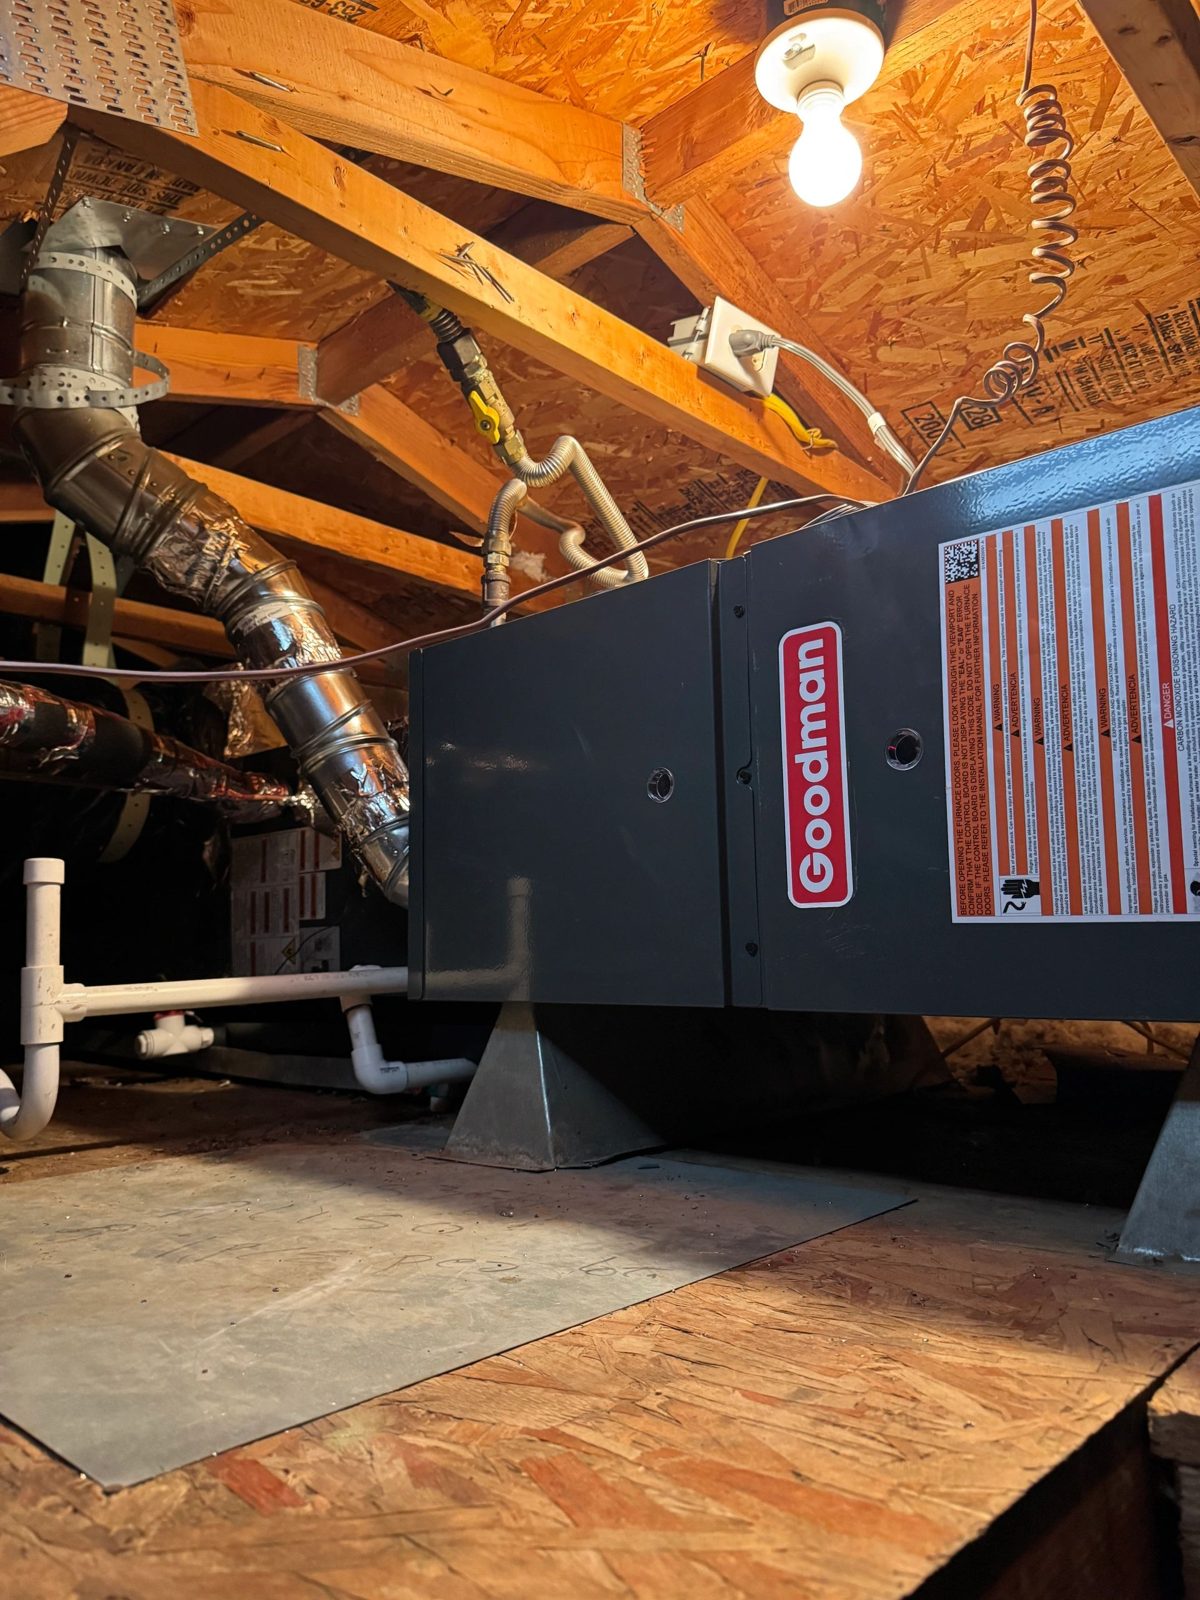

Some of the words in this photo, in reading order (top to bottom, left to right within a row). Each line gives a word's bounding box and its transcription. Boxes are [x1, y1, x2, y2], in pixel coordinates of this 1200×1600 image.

[964, 404, 995, 427] 28
[1169, 604, 1178, 634] HAZARD
[1171, 635, 1180, 677] POISONING
[993, 684, 1001, 721] WARNING
[1099, 687, 1108, 728] WARNING
[1162, 682, 1172, 719] DANGER
[1174, 677, 1183, 718] MONOXIDE
[1033, 697, 1042, 736] WARNING
[1176, 719, 1185, 751] CARBON
[793, 638, 834, 893] Goodman
[969, 737, 977, 784] DISPLAYING
[977, 736, 985, 791] INSTALLATION
[962, 770, 970, 798] BOARD
[955, 790, 963, 827] FURNACE
[971, 794, 979, 822] BOARD
[973, 824, 981, 862] CONTROL
[982, 851, 990, 882] PLEASE
[959, 883, 967, 915] BEFORE
[967, 879, 975, 915] CONFIRM
